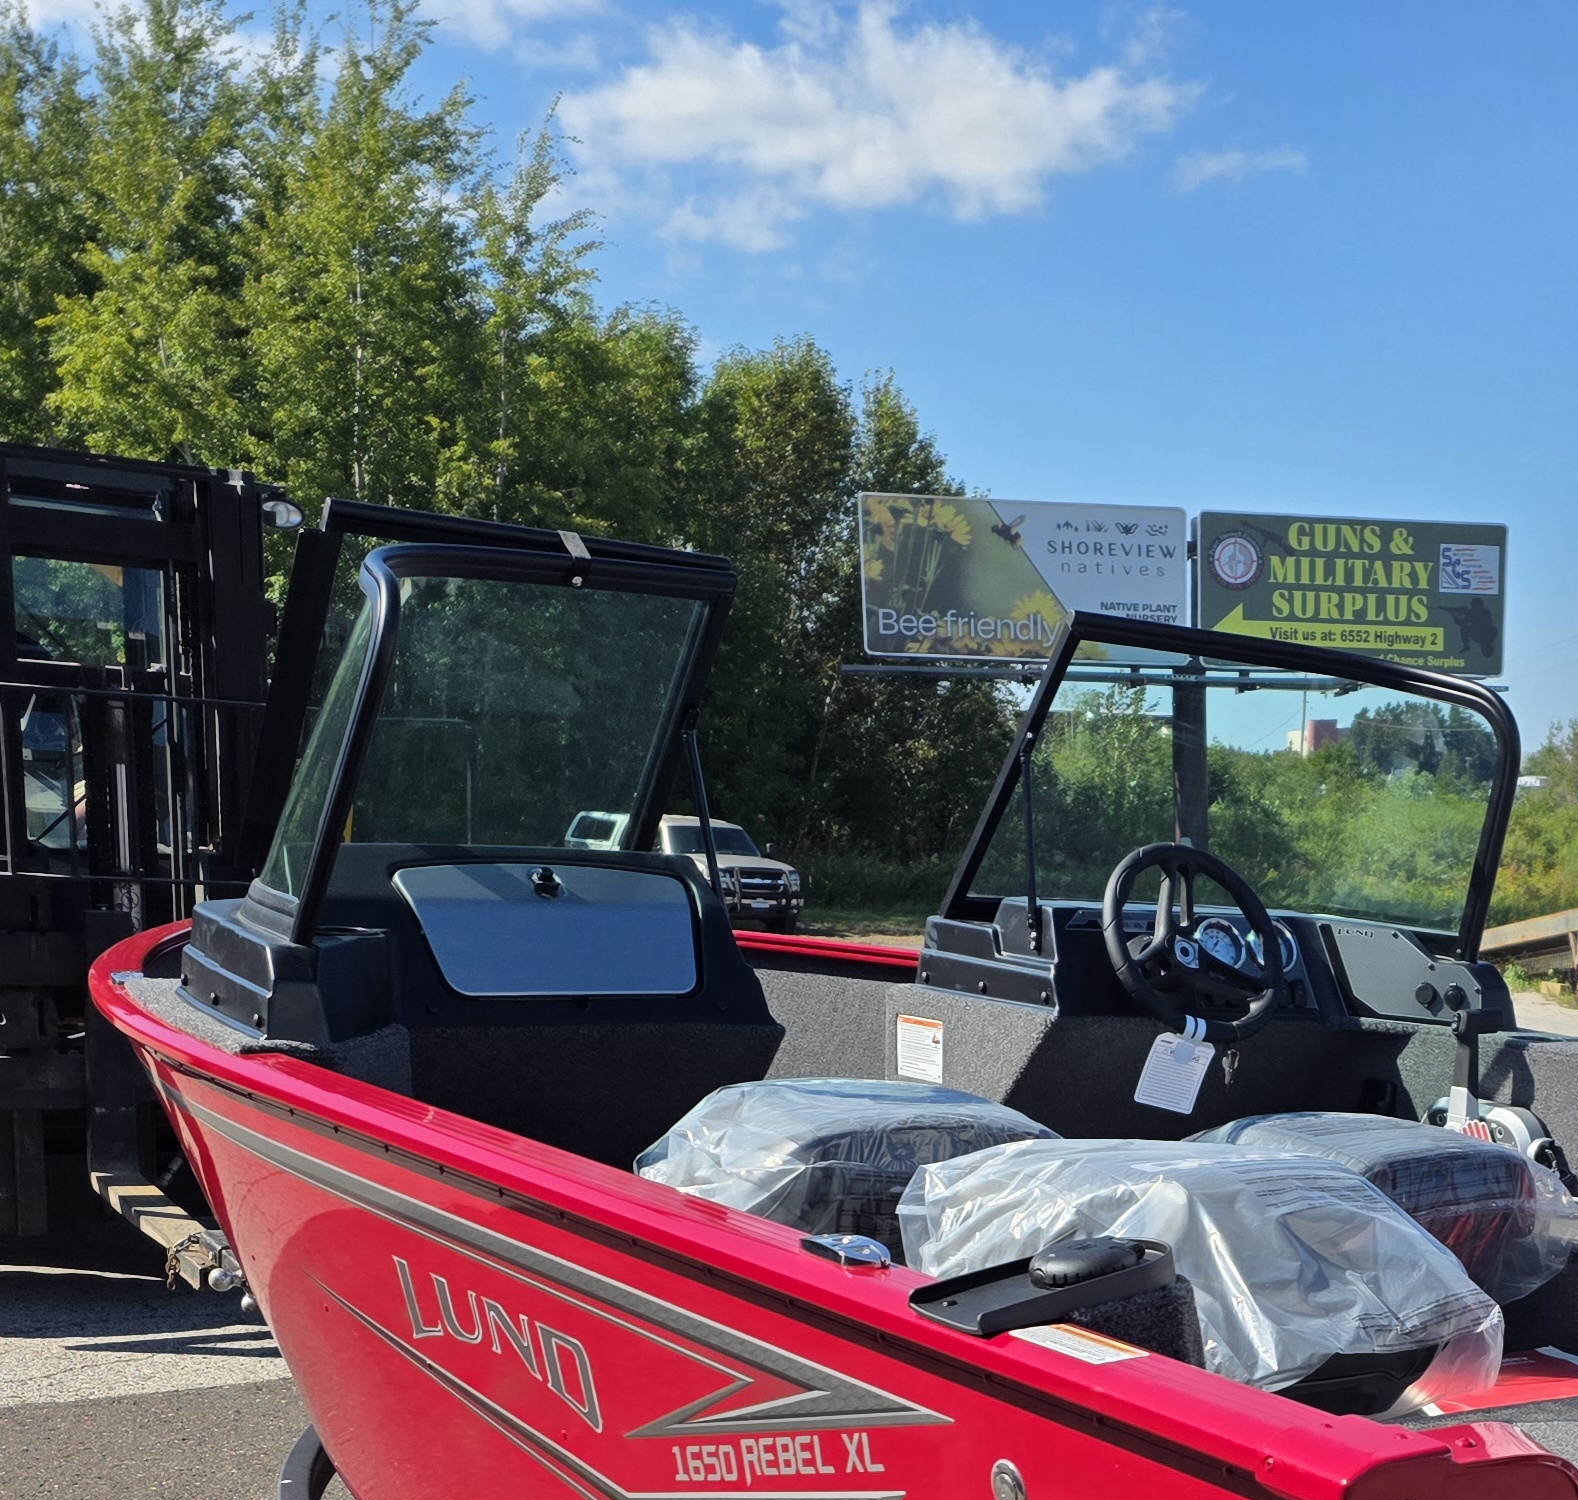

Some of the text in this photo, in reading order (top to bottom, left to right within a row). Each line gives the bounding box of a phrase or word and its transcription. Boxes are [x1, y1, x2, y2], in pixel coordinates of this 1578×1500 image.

[1047, 540, 1177, 559] SHOREVIEW
[1288, 522, 1415, 555] GUNS &
[1061, 560, 1165, 577] natives
[1268, 555, 1434, 589] MILITARY
[1100, 601, 1178, 614] NATIVE PLANT
[1272, 589, 1429, 623] SURPLUS
[878, 608, 1061, 647] Bee friendly
[1269, 626, 1438, 648] Visit us at: 6552 Highway 2
[1386, 653, 1425, 666] Chance
[1427, 655, 1466, 669] Surplus
[391, 1254, 603, 1434] LUND
[672, 1432, 885, 1487] 1650 REBEL XL
